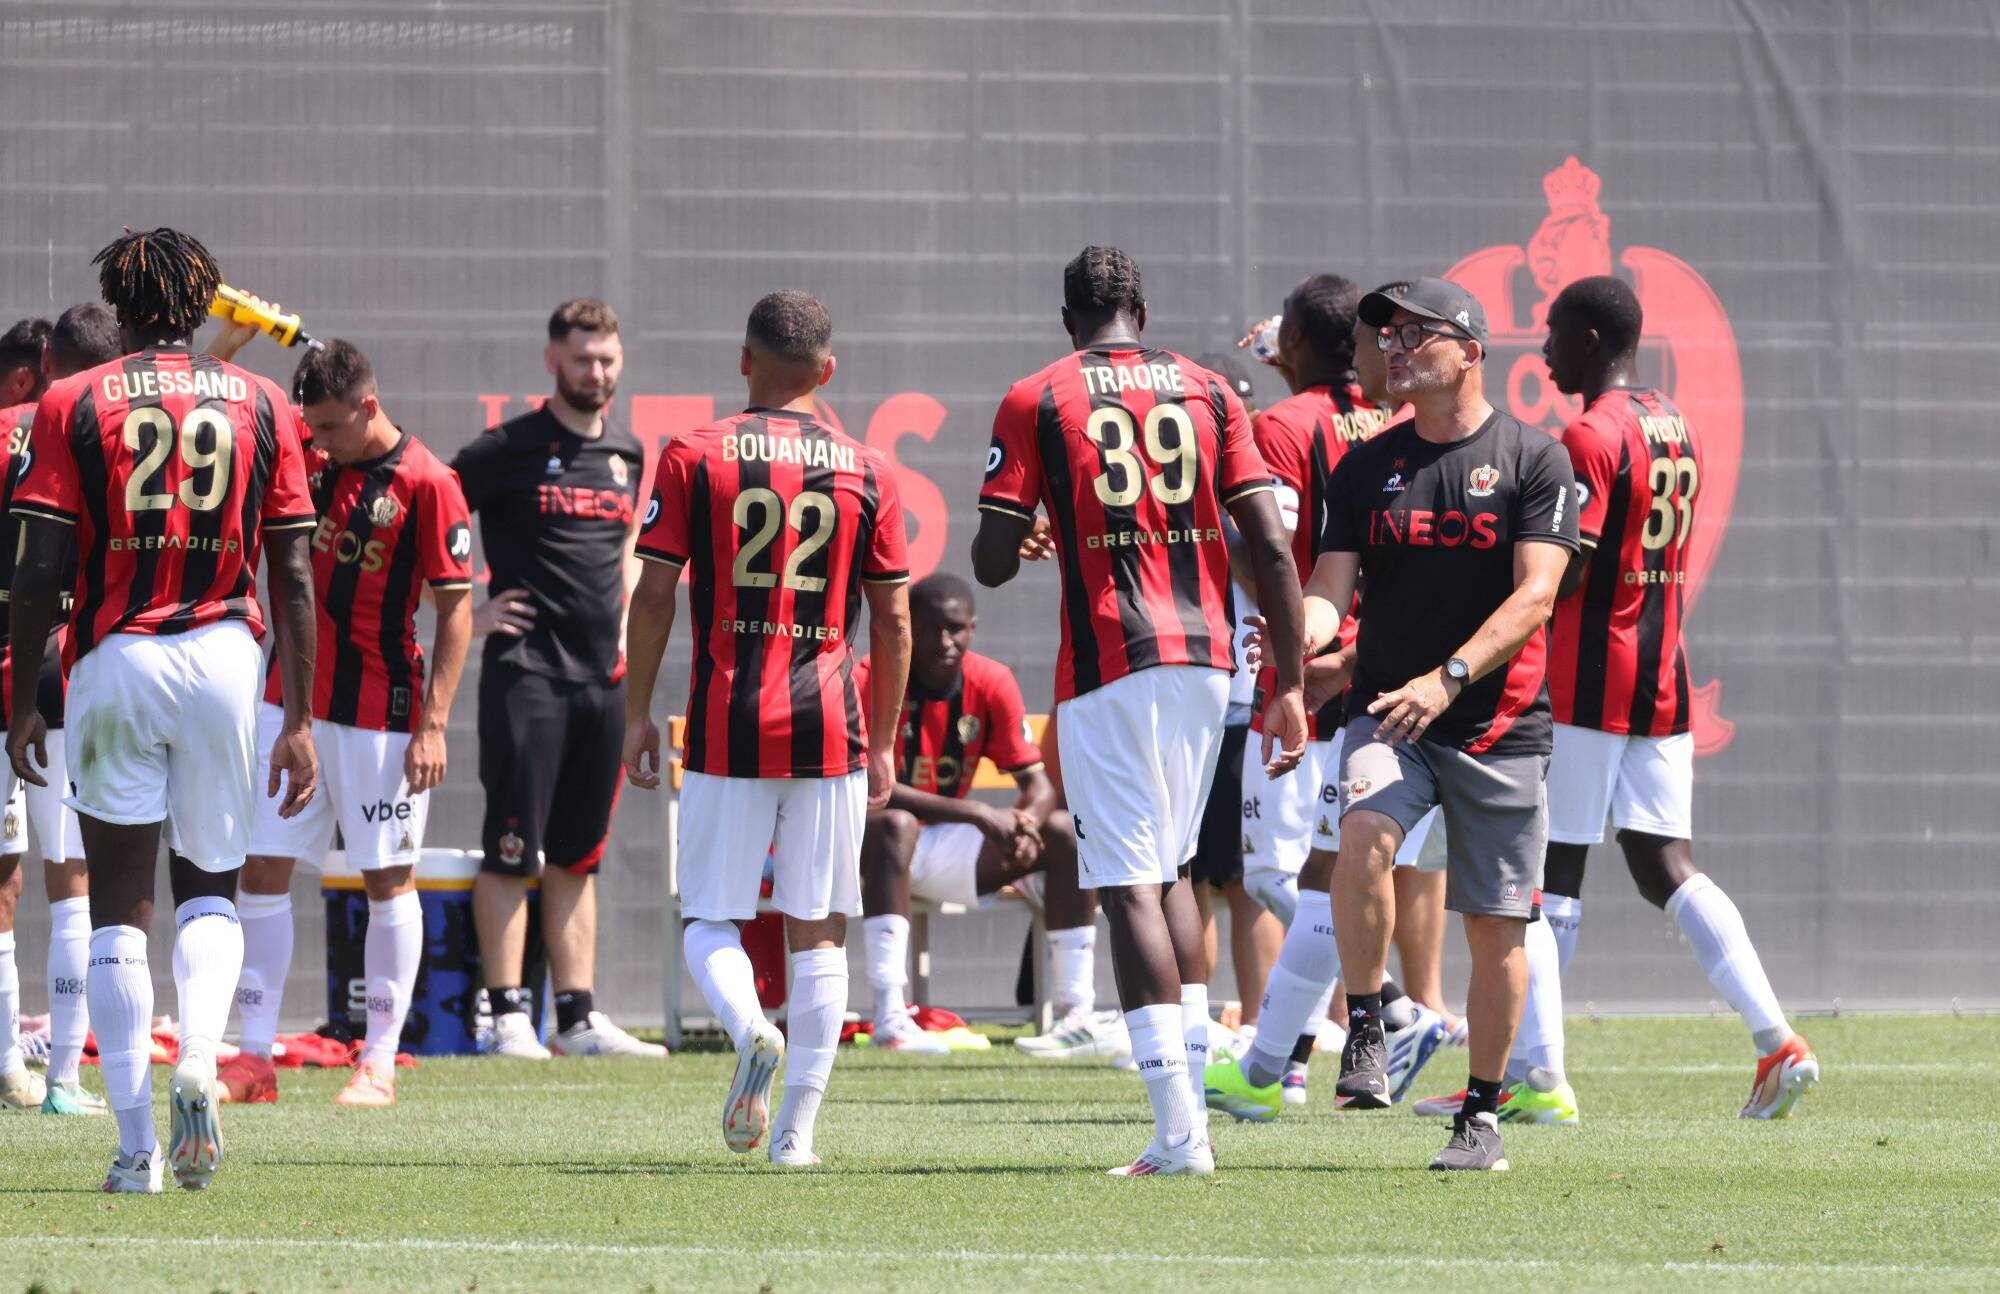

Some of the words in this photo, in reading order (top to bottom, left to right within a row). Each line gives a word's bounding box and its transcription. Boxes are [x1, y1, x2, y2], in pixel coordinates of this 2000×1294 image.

[103, 370, 247, 401] GUESSAND
[1080, 364, 1184, 394] TRAORE
[123, 407, 233, 512] 29
[722, 433, 855, 472] BOUANANI
[1086, 403, 1198, 508] 39
[110, 535, 239, 553] GRENADIER
[311, 515, 386, 573] EOS
[732, 487, 838, 592] 22
[1086, 528, 1220, 550] GRENADIER
[1368, 508, 1499, 550] INEOS
[722, 618, 840, 642] GRENADIER
[361, 798, 417, 823] vbe
